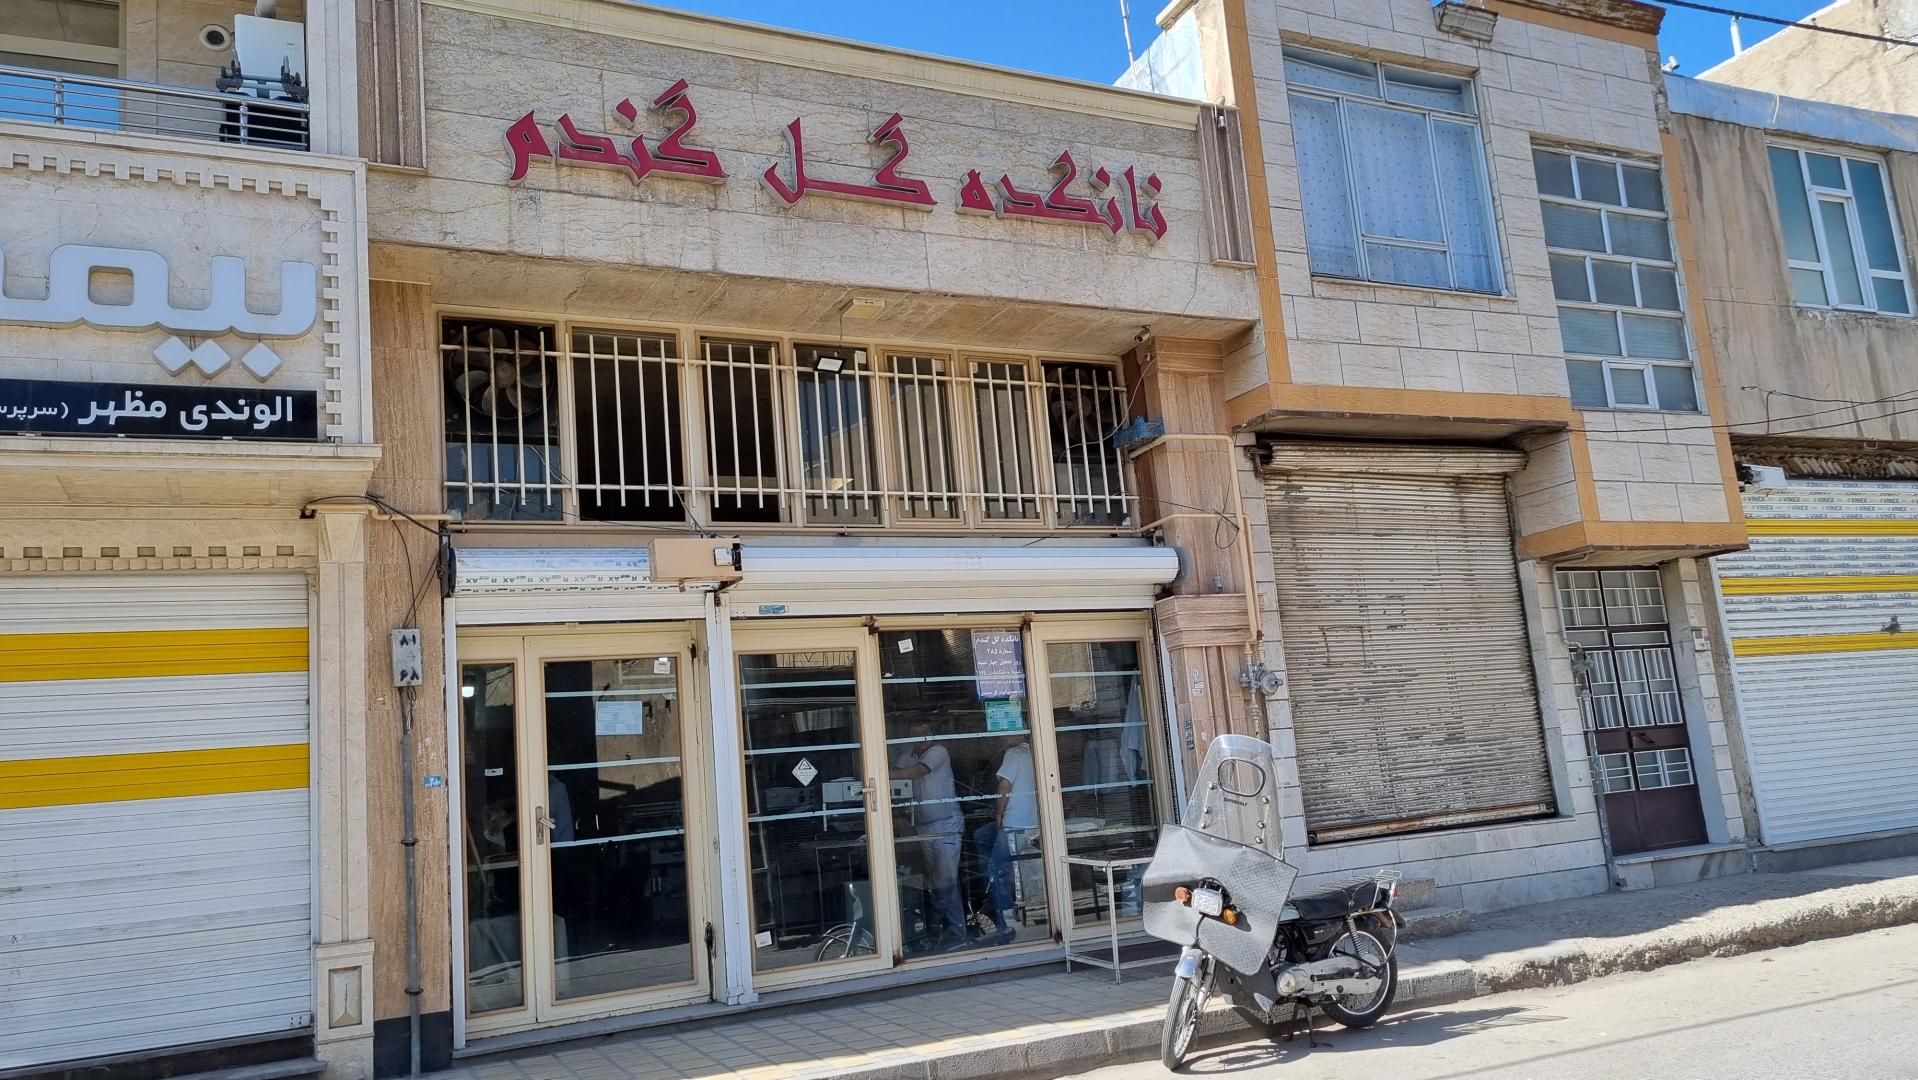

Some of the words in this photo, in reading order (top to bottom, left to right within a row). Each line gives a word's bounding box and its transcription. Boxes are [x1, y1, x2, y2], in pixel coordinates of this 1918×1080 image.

[503, 78, 729, 184] گندم
[760, 112, 938, 206] گل
[957, 150, 1168, 243] نانکده
[0, 244, 317, 380] بیم
[77, 390, 167, 425] مظهر
[180, 395, 293, 431] الوندی
